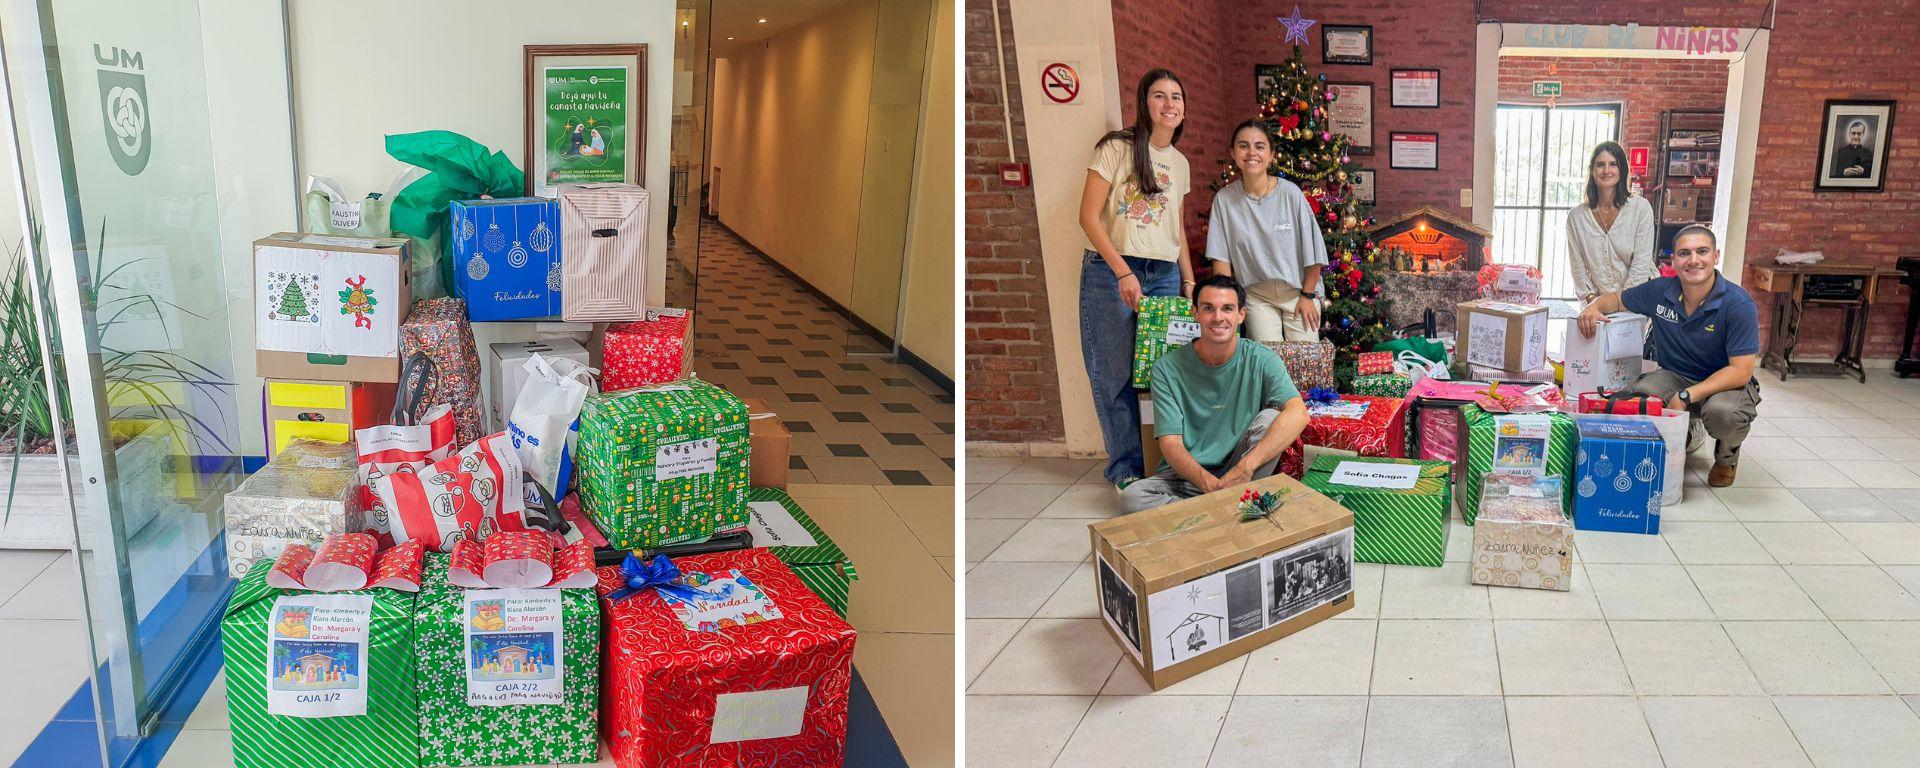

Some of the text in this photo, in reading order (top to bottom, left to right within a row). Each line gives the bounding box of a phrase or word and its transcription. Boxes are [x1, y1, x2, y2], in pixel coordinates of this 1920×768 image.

[1524, 24, 1588, 49] CLUB
[93, 43, 144, 70] UM
[1663, 305, 1679, 321] UM
[508, 420, 540, 447] mino es
[524, 598, 552, 606] Kimberly
[333, 607, 361, 616] Kimberly
[523, 605, 547, 613] Alarcón
[329, 615, 354, 623] Alarcón
[521, 614, 549, 623] Margara
[312, 624, 324, 632] De:
[326, 625, 355, 634] Margara
[495, 683, 539, 692] CAJA 2/2
[296, 692, 341, 703] CAJA 1/2
